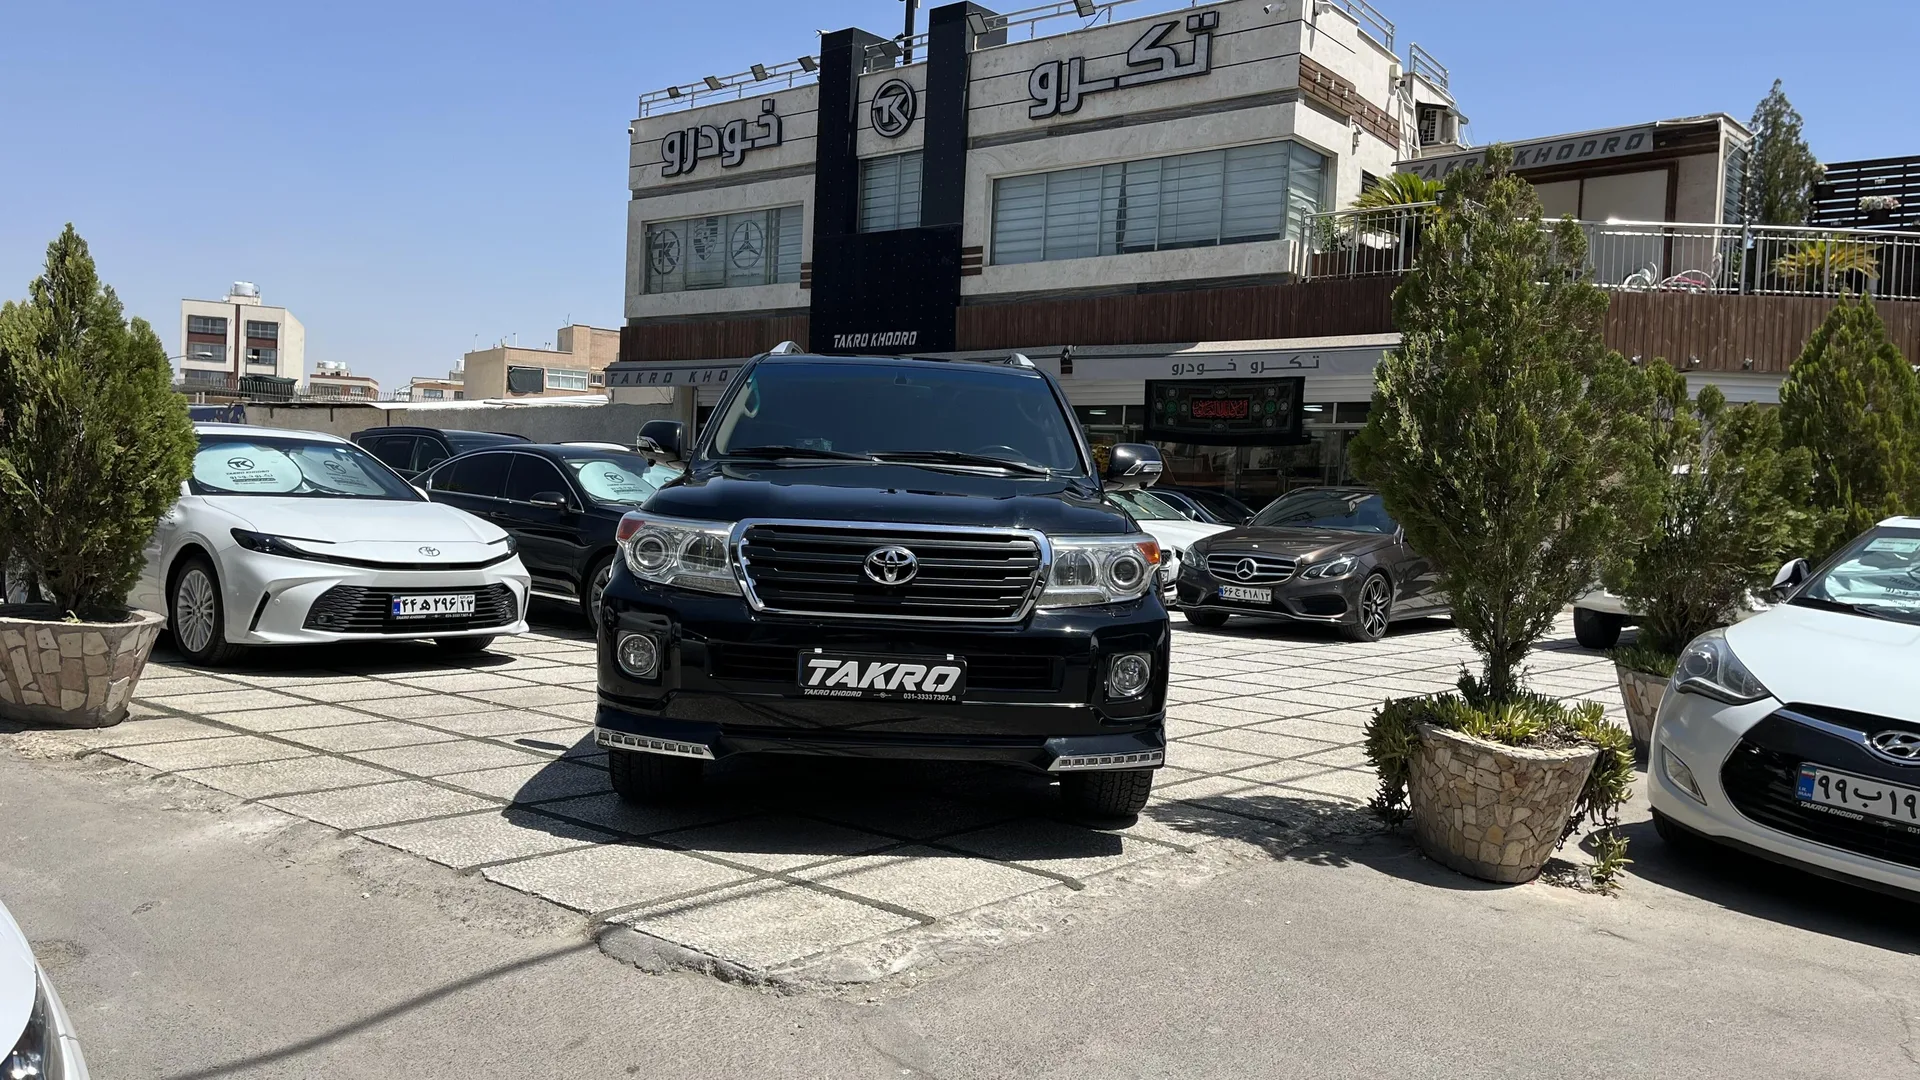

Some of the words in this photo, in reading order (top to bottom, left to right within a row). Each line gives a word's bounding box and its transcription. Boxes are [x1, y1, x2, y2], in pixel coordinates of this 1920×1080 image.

[1029, 11, 1219, 119] تکرو
[662, 99, 782, 177] خودرو
[1411, 157, 1480, 180] TAKR
[1513, 133, 1645, 166] KHODRO
[834, 333, 869, 348] TAKRO
[870, 331, 917, 347] KHODRO
[1171, 358, 1237, 375] خودرو
[1250, 355, 1320, 374] تکرو
[610, 372, 673, 384] TAKRO
[689, 369, 739, 383] KHO
[807, 659, 961, 692] TAKRO
[804, 688, 830, 696] TAKRO
[830, 690, 863, 698] KHODRO
[1800, 800, 1829, 813] TAKRO
[1828, 807, 1864, 821] KHODRO
